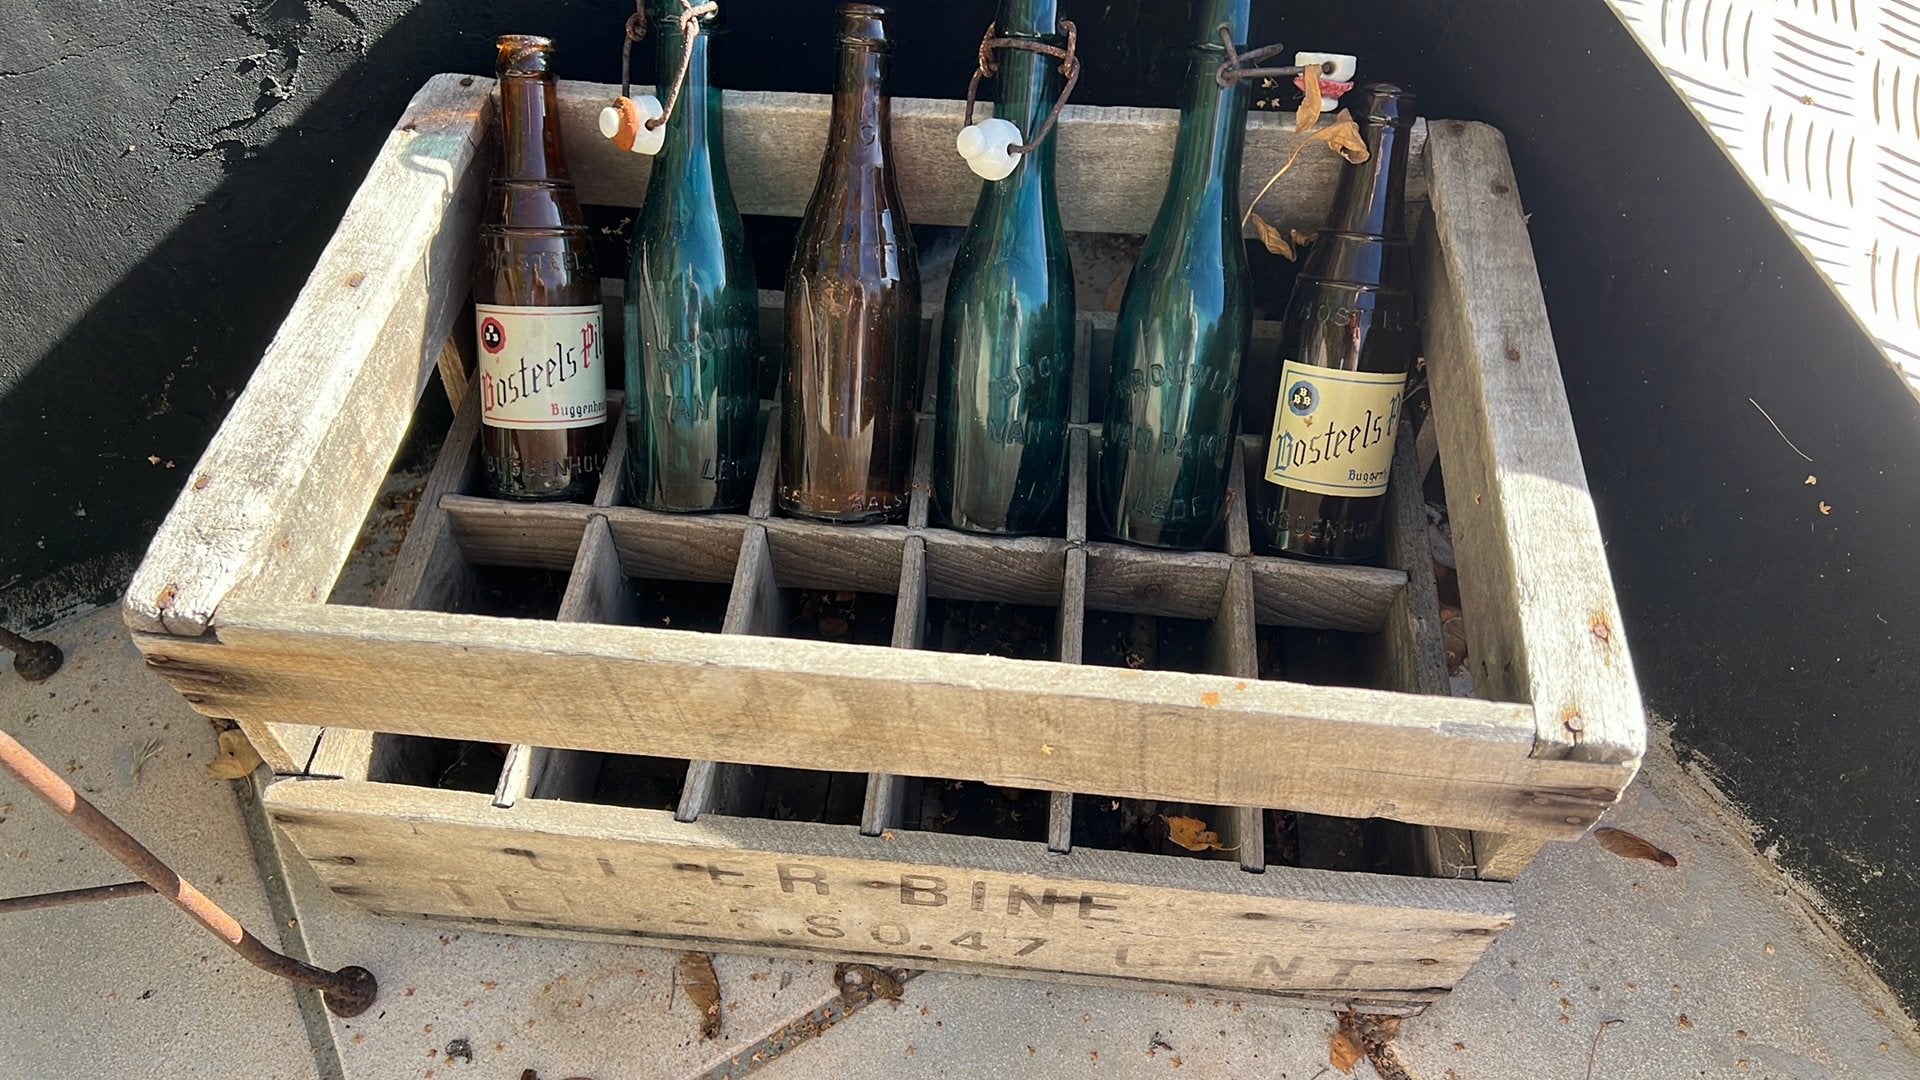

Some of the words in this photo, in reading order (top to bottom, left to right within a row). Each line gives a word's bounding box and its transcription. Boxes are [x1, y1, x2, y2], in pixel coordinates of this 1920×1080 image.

[482, 342, 577, 413] Bosteels
[580, 315, 604, 369] Pil
[1272, 409, 1383, 473] Bosteels
[900, 873, 1130, 923] BINE
